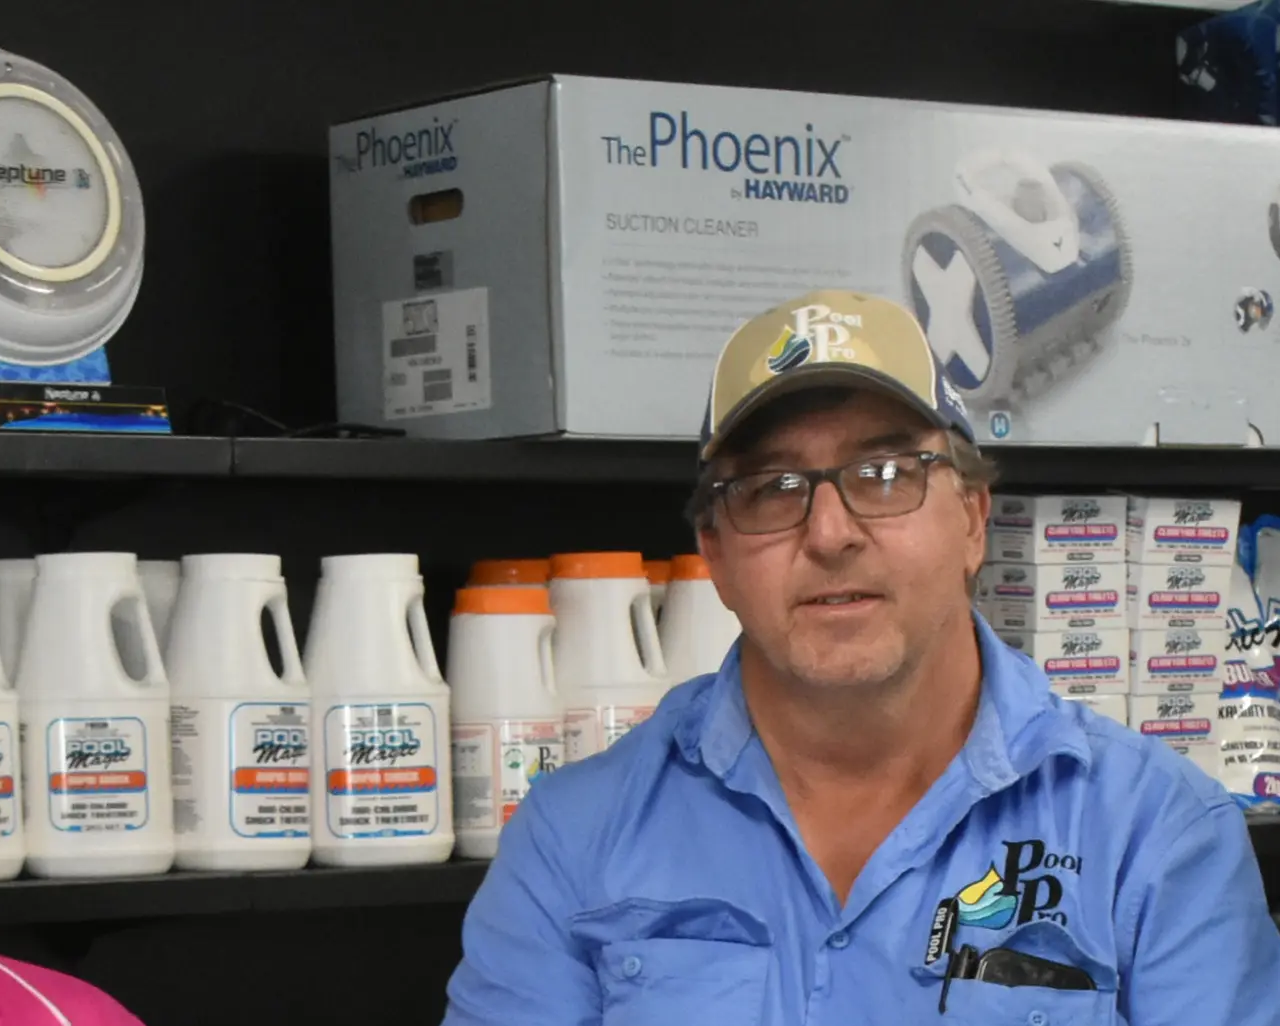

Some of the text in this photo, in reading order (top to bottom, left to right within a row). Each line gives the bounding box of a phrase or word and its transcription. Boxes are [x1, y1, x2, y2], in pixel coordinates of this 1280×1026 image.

[355, 116, 454, 171] Phoenix
[601, 111, 842, 179] The Phoenix
[745, 179, 849, 204] HAYWARD
[606, 213, 759, 238] SUCTION CLEANER
[791, 304, 863, 342] Pool
[66, 739, 131, 756] POOL
[348, 728, 420, 748] POOL
[66, 752, 131, 769] Magic
[344, 745, 420, 765] Magic
[994, 839, 1083, 896] Pool
[1017, 874, 1068, 928] Pro
[926, 906, 948, 963] POOL PRO
